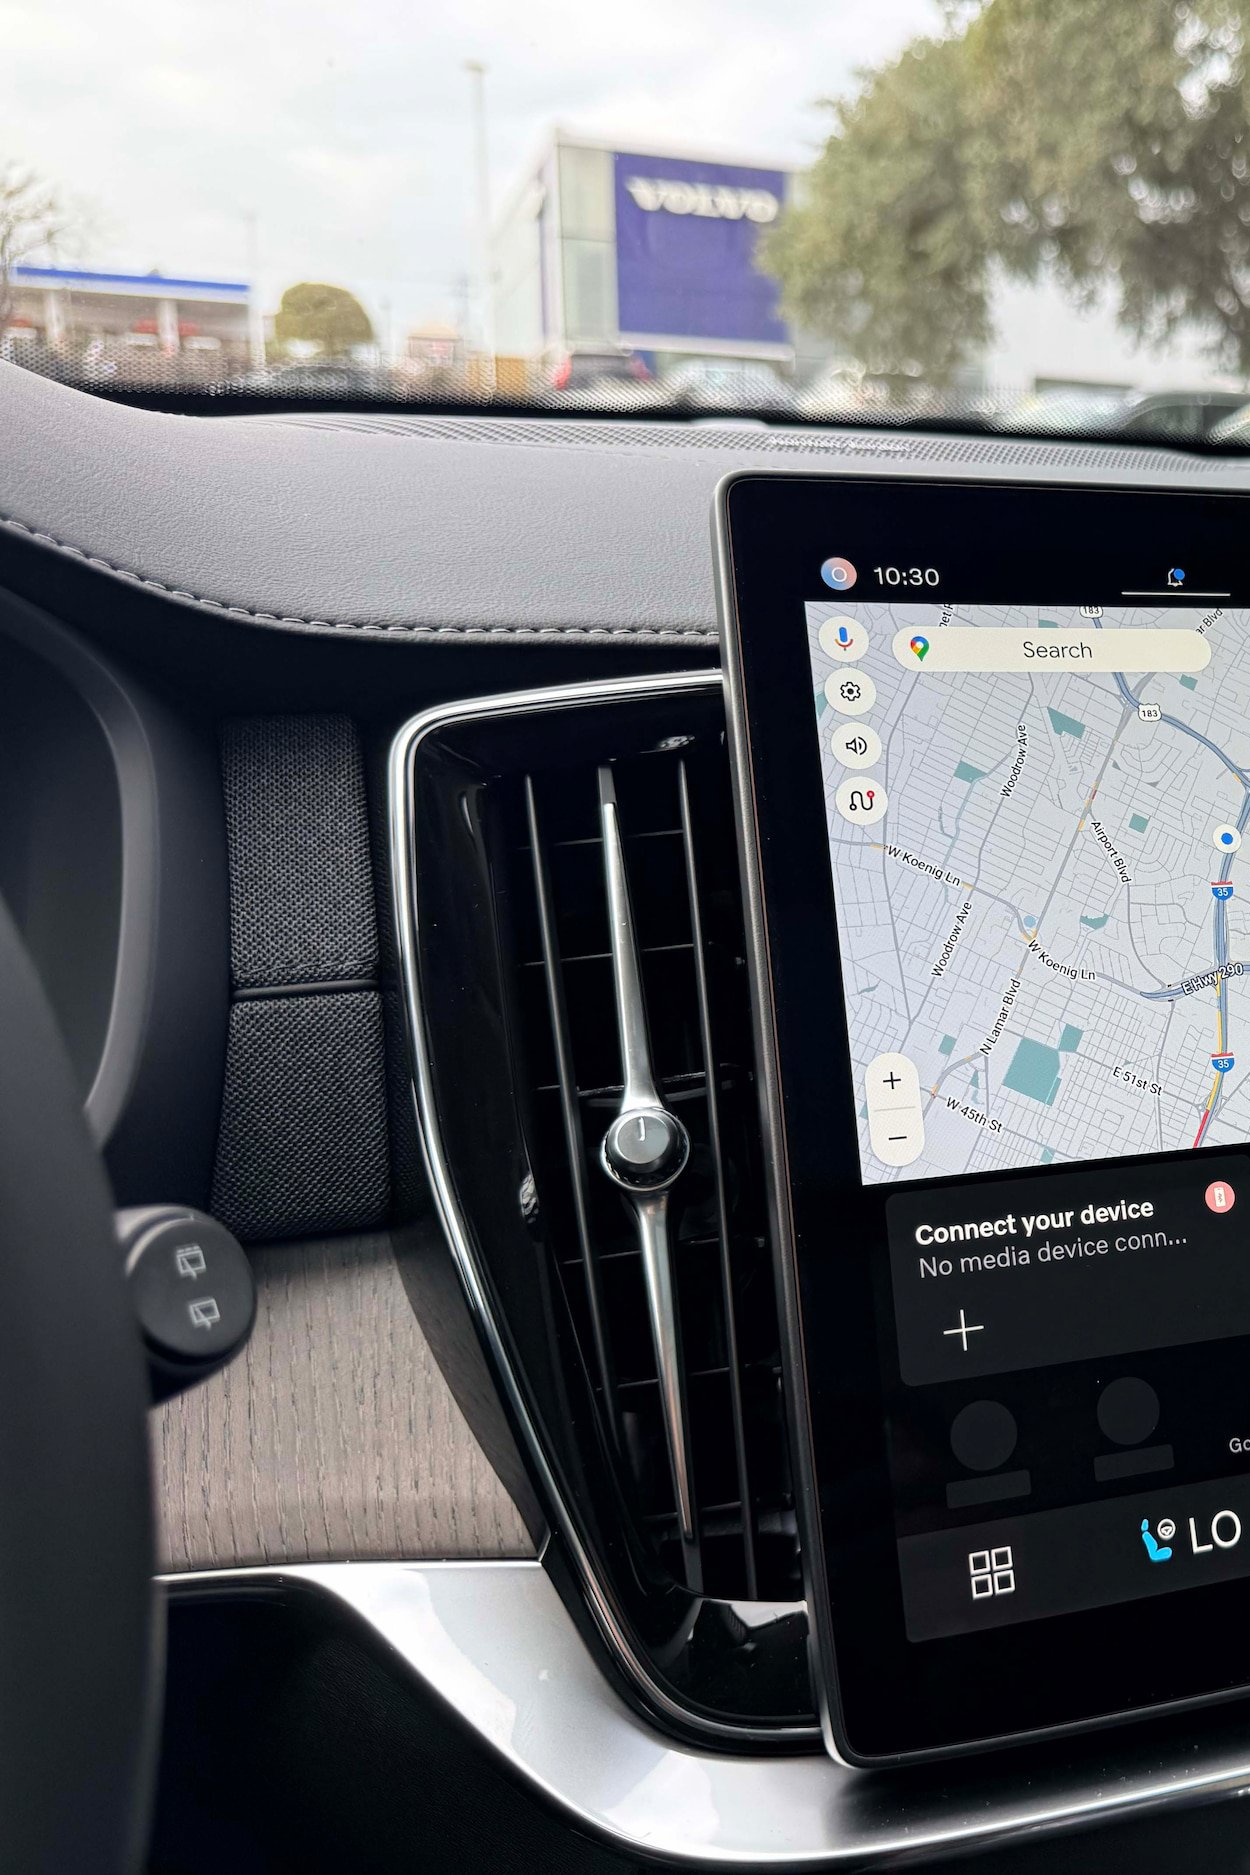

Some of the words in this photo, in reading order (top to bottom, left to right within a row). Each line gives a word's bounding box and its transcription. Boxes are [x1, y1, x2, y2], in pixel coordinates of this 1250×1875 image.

[626, 177, 778, 222] VOLVO
[873, 566, 940, 587] 10:30
[1202, 608, 1223, 627] Blvd
[1022, 640, 1093, 660] Search
[1142, 709, 1157, 718] 183
[1000, 748, 1026, 797] Woodrow
[1018, 724, 1028, 746] Ave
[888, 845, 901, 857] W
[902, 852, 943, 880] Koenig
[945, 871, 961, 886] Ln
[1091, 822, 1118, 857] Airport
[1113, 857, 1132, 883] Blvd
[1217, 887, 1229, 897] 35
[931, 924, 962, 976] Woodrow
[956, 902, 972, 924] Ave
[1028, 939, 1041, 952] W
[1038, 951, 1078, 980] Koenig
[1081, 969, 1095, 980] Ln
[1181, 981, 1194, 995] E
[1191, 971, 1218, 991] Hwy
[1218, 963, 1243, 980] 290
[979, 1043, 992, 1055] N
[986, 1006, 1009, 1044] Lamar
[1002, 978, 1021, 1005] Blvd
[1113, 1066, 1122, 1078] E
[1123, 1071, 1147, 1090] 51st
[1150, 1083, 1162, 1096] St
[1217, 1059, 1229, 1069] 35
[947, 1097, 960, 1110] W
[960, 1106, 987, 1126] 45th
[989, 1119, 1002, 1133] St
[915, 1214, 1017, 1246] Connect
[1021, 1209, 1075, 1238] your
[1080, 1200, 1154, 1226] device
[919, 1256, 953, 1279] No
[960, 1246, 1031, 1274] media
[1037, 1236, 1109, 1263] device
[1115, 1231, 1187, 1252] conn...
[1189, 1510, 1242, 1555] LO
